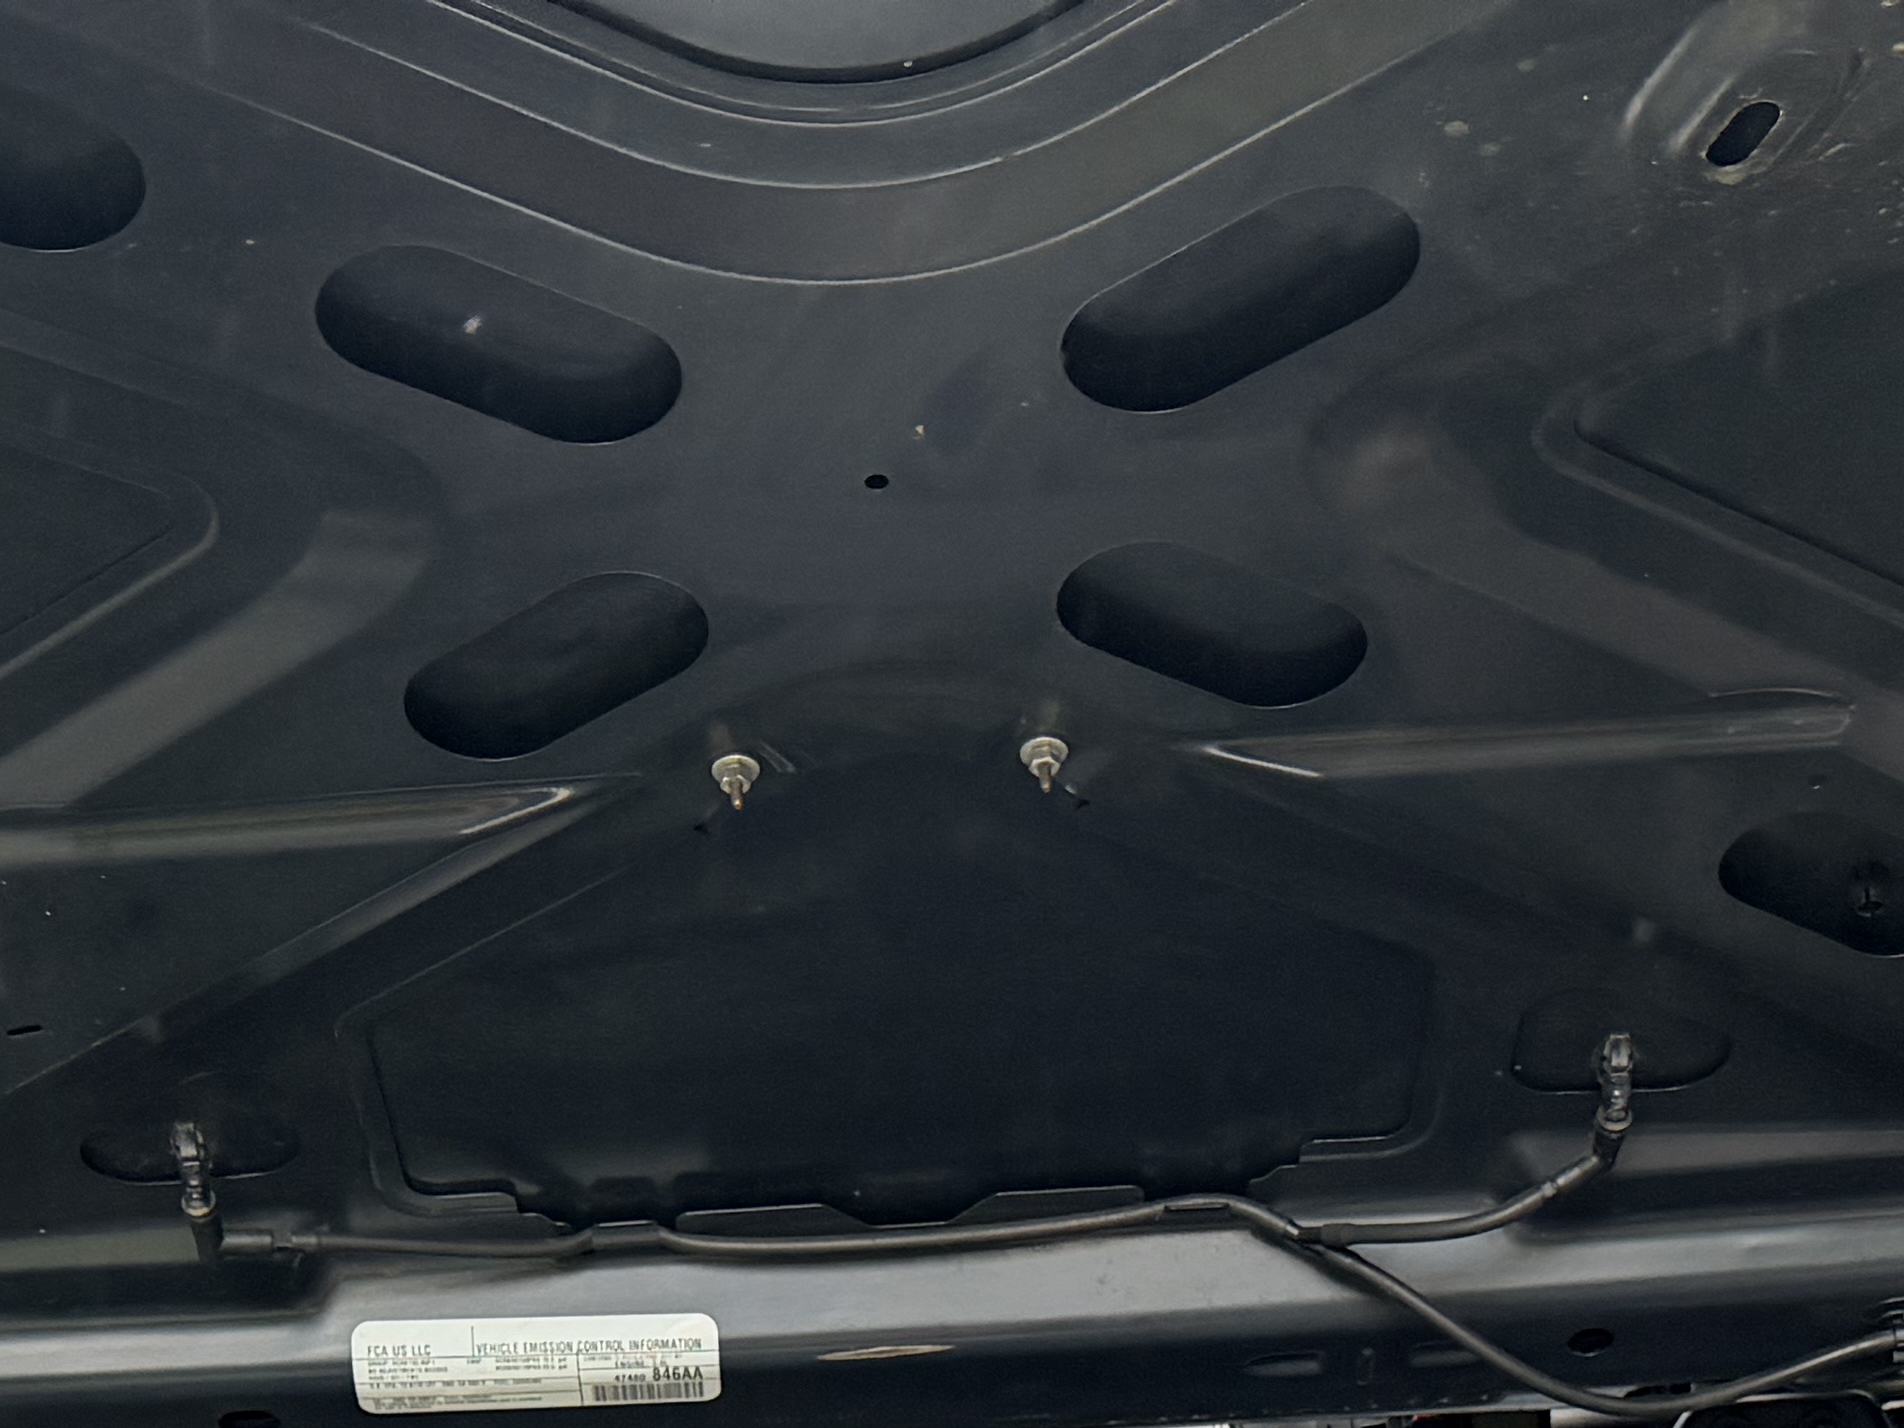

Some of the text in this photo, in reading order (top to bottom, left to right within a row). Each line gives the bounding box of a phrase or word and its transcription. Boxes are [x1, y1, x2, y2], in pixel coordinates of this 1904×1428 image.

[367, 1344, 431, 1357] FCA US LLC
[476, 1338, 702, 1355] VEHICLE EMISSION CONTROL INFORMATION
[653, 1365, 704, 1382] 846AA
